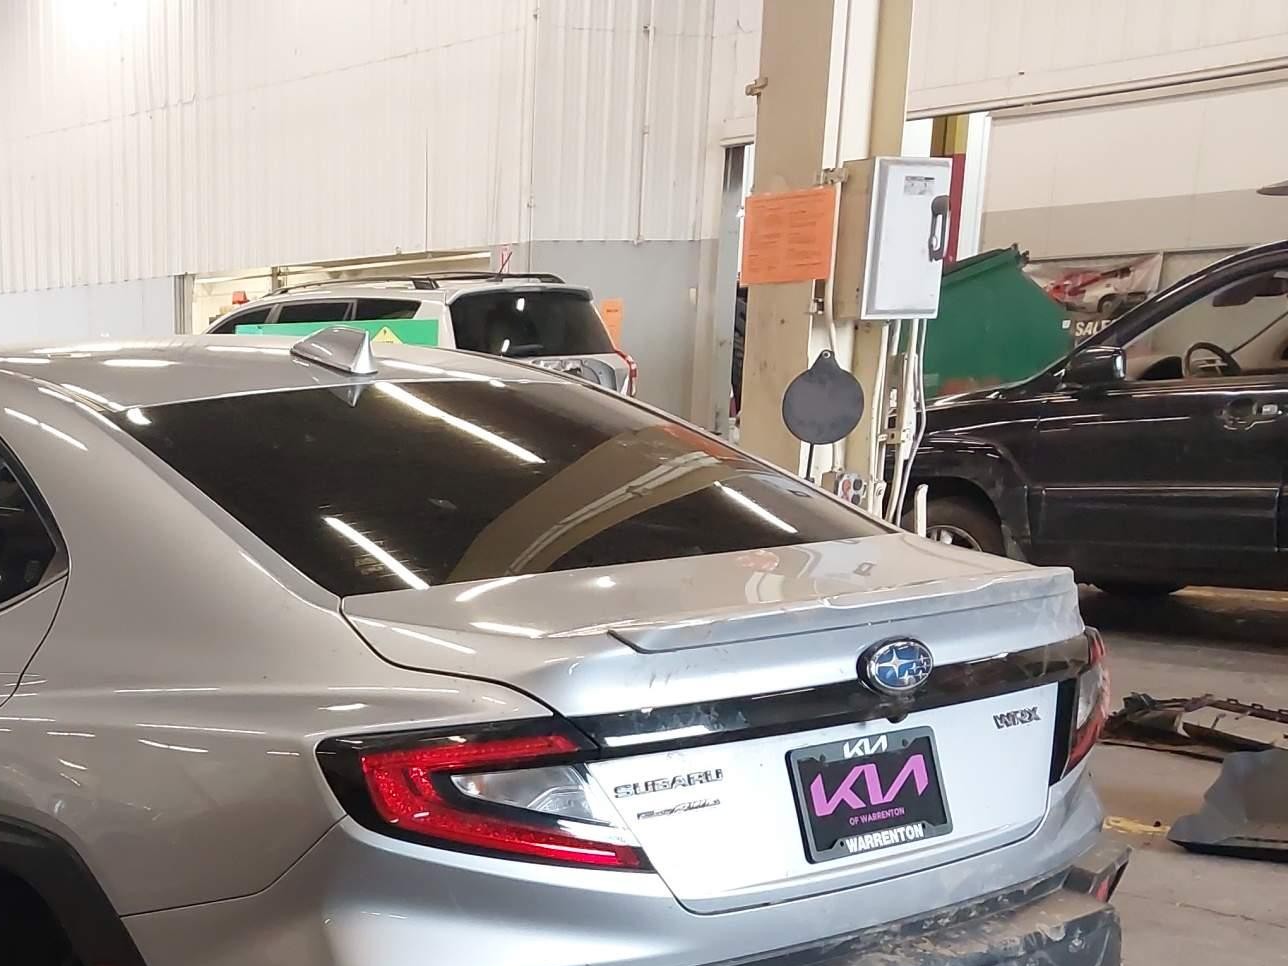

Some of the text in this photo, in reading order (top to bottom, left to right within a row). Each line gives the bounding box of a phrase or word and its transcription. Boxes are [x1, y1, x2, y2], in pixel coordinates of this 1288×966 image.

[993, 706, 1041, 729] WRX
[843, 735, 888, 759] KIA
[613, 768, 724, 799] SUBARU
[810, 754, 929, 817] KIA
[849, 807, 905, 826] OF WARRENTON
[845, 823, 924, 853] WARRENTON
